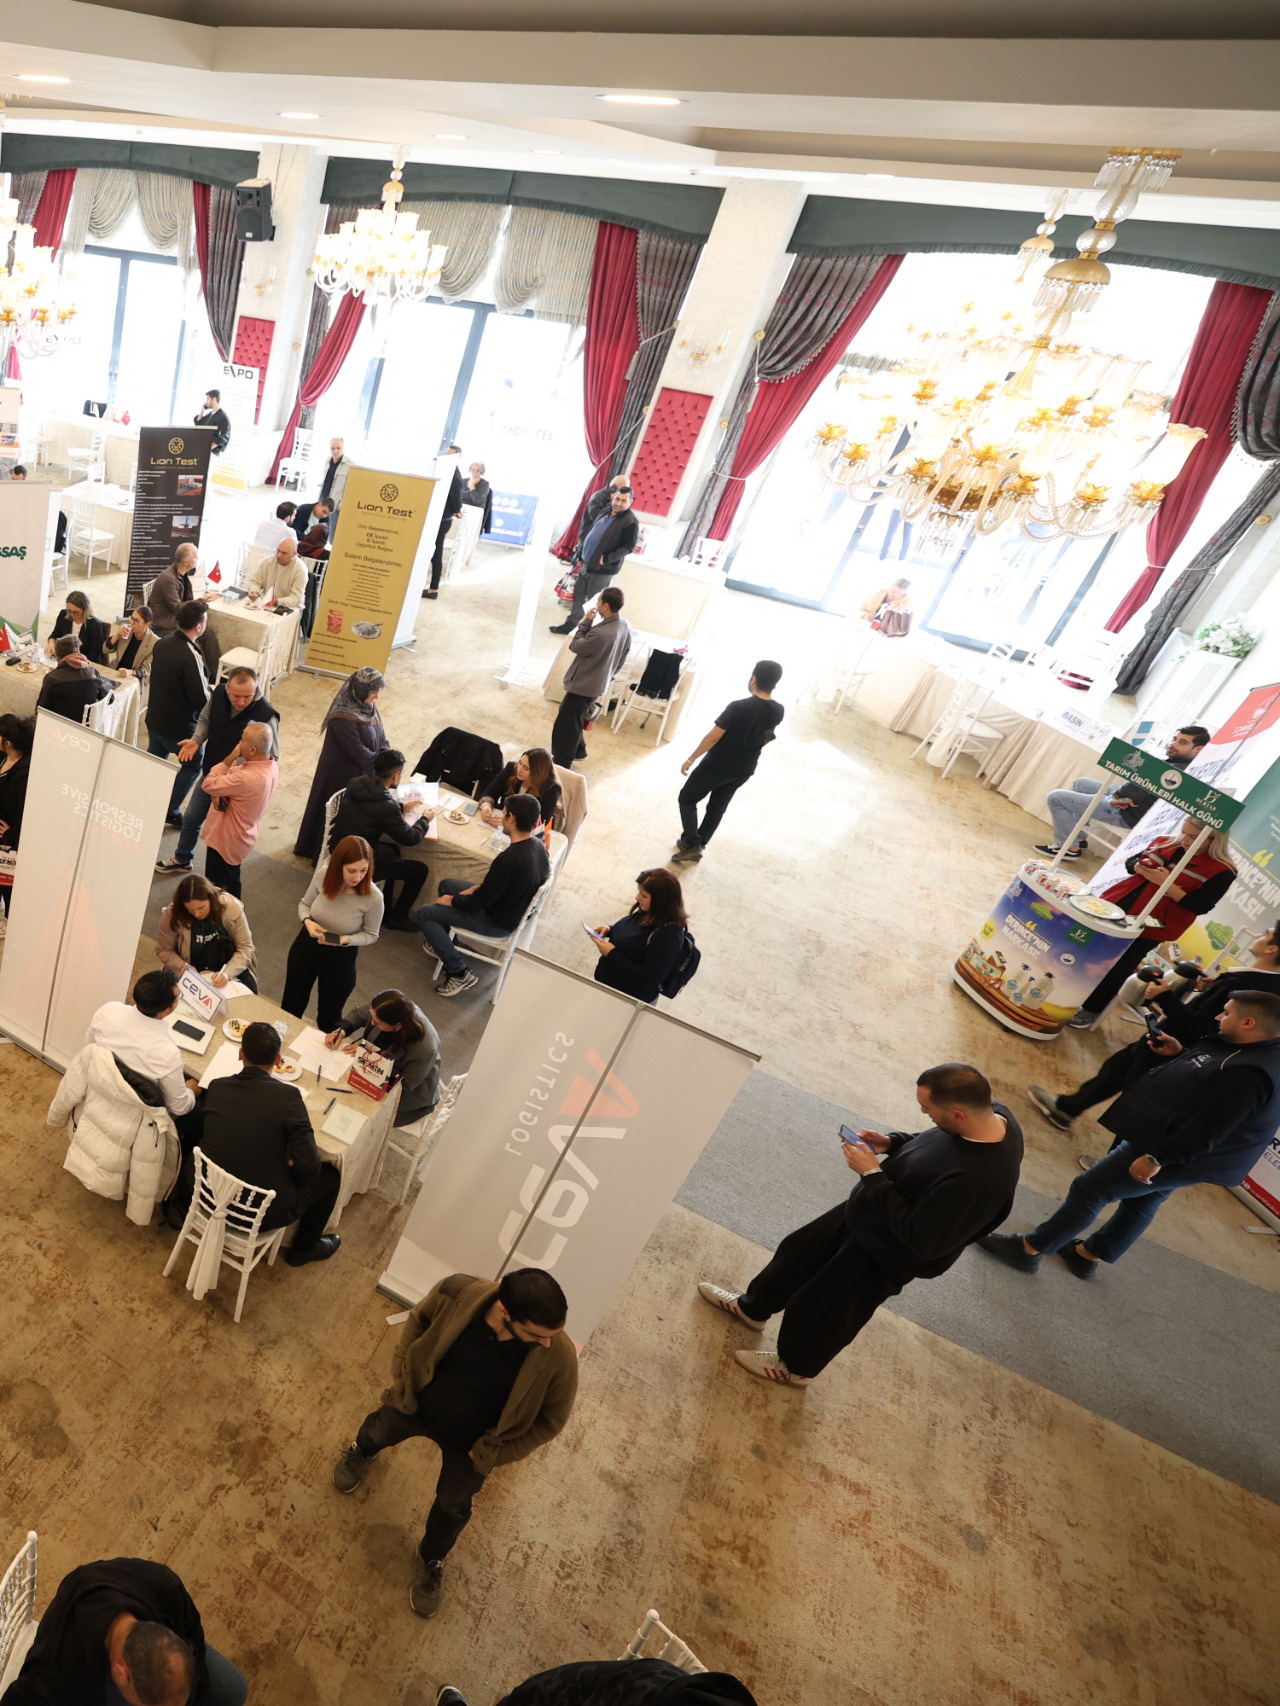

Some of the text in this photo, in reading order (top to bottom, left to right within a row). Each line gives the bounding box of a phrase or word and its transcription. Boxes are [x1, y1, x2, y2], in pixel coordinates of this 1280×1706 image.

[150, 457, 198, 466] Lion Test
[357, 501, 413, 518] Lion Test
[344, 551, 362, 560] Sistem
[1061, 711, 1084, 729] BASIN
[1105, 760, 1131, 779] TARIM
[1130, 772, 1173, 805] ÜRÜNLERİ
[1171, 796, 1198, 816] HALK
[1195, 808, 1224, 830] GÜNÜ
[1001, 925, 1040, 960] MARKASI!
